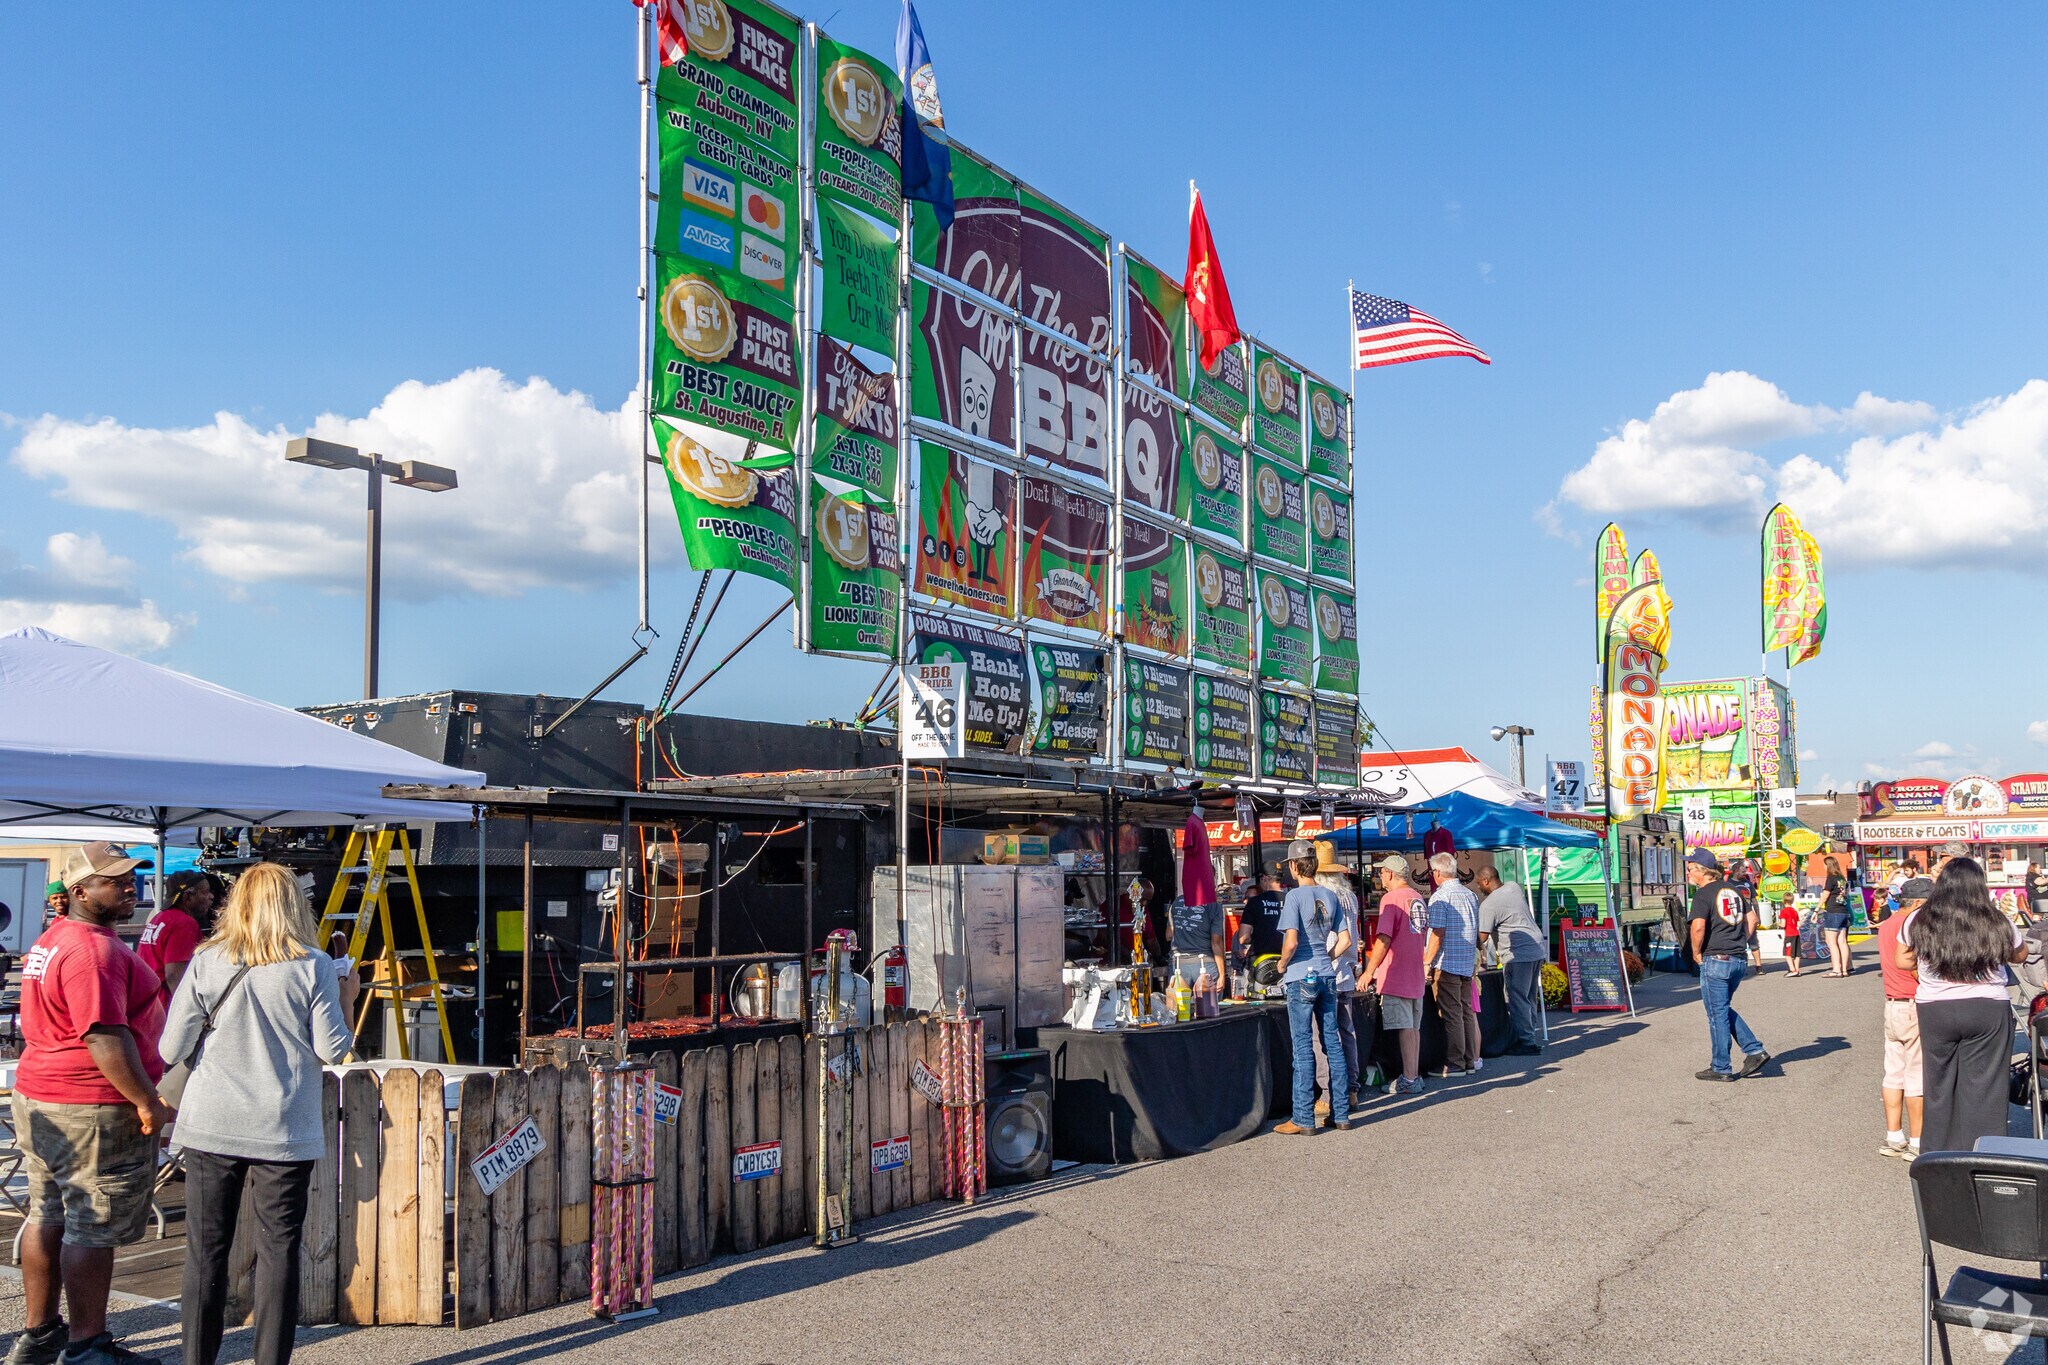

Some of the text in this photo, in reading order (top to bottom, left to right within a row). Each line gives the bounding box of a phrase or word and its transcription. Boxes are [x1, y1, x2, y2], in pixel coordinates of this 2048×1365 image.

[687, 0, 721, 37] 1st
[741, 21, 785, 63] FIRST
[740, 42, 787, 90] PLACE
[842, 78, 876, 124] 1st
[696, 91, 773, 140] Auburn, NY
[667, 110, 793, 184] WE ACCEPT ALL MAJOR
[698, 140, 774, 187] CREDIT CARDS
[841, 163, 860, 179] Music
[692, 172, 729, 203] VISA
[819, 169, 830, 186] (4
[831, 173, 859, 195] YEARS!
[859, 186, 878, 208] 2018,
[873, 163, 894, 190] CHOICE
[684, 224, 731, 254] AMEX
[826, 217, 880, 272] You Don't
[743, 245, 783, 271] DISCOVER
[837, 254, 871, 294] Teeth
[873, 275, 886, 303] To
[680, 295, 722, 341] 1st
[847, 294, 872, 330] Our
[955, 250, 1082, 373] Off The
[746, 315, 788, 351] FIRST
[742, 338, 792, 376] PLACE
[1224, 349, 1240, 368] FIRST
[834, 351, 857, 388] Off
[1224, 360, 1243, 380] PLACE
[667, 360, 795, 418] "BEST SAUCE"
[1225, 372, 1243, 392] 2022
[1265, 371, 1278, 400] 1st
[675, 390, 785, 441] St. Augustine, FL
[1197, 391, 1238, 427] Mobile, Alabama
[1317, 401, 1332, 428] 1st
[1009, 354, 1163, 511] BBQ
[863, 441, 882, 465] $35
[1200, 446, 1215, 476] 1st
[1223, 454, 1240, 471] FIRST
[829, 453, 882, 487] 2X-3X $40
[1223, 465, 1241, 483] PLACE
[1025, 480, 1095, 520] Don't To
[1263, 477, 1277, 506] 1st
[1284, 493, 1301, 510] PLACE
[1285, 482, 1300, 498] FIRST
[835, 504, 866, 550] 1st
[870, 511, 896, 533] FIRST
[1317, 501, 1330, 529] 1st
[871, 530, 897, 553] PLACE
[877, 548, 898, 570] 2021
[1202, 564, 1217, 594] 1st
[1224, 569, 1241, 585] FIRST
[1771, 511, 1803, 646] LEMONADE
[926, 573, 1007, 606] wearetheboners.com
[1154, 586, 1167, 598] OHIO
[1224, 581, 1243, 598] PLACE
[1226, 594, 1242, 609] 2021
[1267, 587, 1283, 616] 1st
[824, 606, 859, 625] LIONS
[1322, 604, 1336, 630] 1st
[915, 615, 950, 638] ORDER
[951, 624, 966, 641] BY
[967, 628, 984, 644] THE
[1266, 648, 1281, 660] LIONS
[1273, 634, 1293, 652] "BEST
[920, 665, 950, 679] BBQ
[970, 651, 1024, 681] Hank,
[1039, 650, 1080, 672] 2 BBC
[927, 679, 953, 688] RIVER
[1057, 668, 1098, 682] CHICKEN SANDWICH
[1130, 664, 1178, 687] 5 6 Biguns
[1149, 682, 1159, 692] RIBS
[975, 676, 1021, 703] Hook
[1046, 685, 1095, 709] 3 Teaser
[1199, 682, 1208, 700] 8
[1669, 684, 1735, 694] SQUEEZED
[968, 700, 1024, 730] Me Up!
[1146, 697, 1182, 719] 12 Biguns
[1150, 715, 1160, 725] RIBS
[1665, 693, 1743, 746] ONADE
[1052, 721, 1098, 739] Pleaser
[1199, 712, 1247, 734] 9 Poor Piggy
[1213, 728, 1223, 738] PORK
[1265, 725, 1275, 742] 12
[1318, 721, 1341, 732] Extra Sides
[1755, 681, 1781, 789] LEMONADE
[911, 733, 956, 742] OFF THE BONE
[1058, 740, 1069, 749] RIBS
[1131, 730, 1179, 751] 7 Slim J
[1199, 744, 1249, 762] 10 Meat Pete
[1237, 803, 1251, 811] Line
[1242, 812, 1248, 826] 1
[1325, 813, 1331, 826] 2
[1984, 823, 2039, 835] SOFT SERVE
[1863, 827, 1914, 838] ROOTBEER
[1926, 826, 1967, 837] FLOATS
[1763, 883, 1791, 892] LIMEADE
[1572, 931, 1609, 939] DRINKS
[1570, 959, 1583, 1004] PANINIS
[914, 1067, 928, 1086] PIM
[654, 1091, 677, 1116] 6298
[495, 1134, 511, 1150] OHIO
[890, 1143, 909, 1162] 6298
[480, 1126, 539, 1185] PIM 8879
[506, 1159, 527, 1175] TRUCK
[738, 1150, 778, 1174] CWBYCSR
